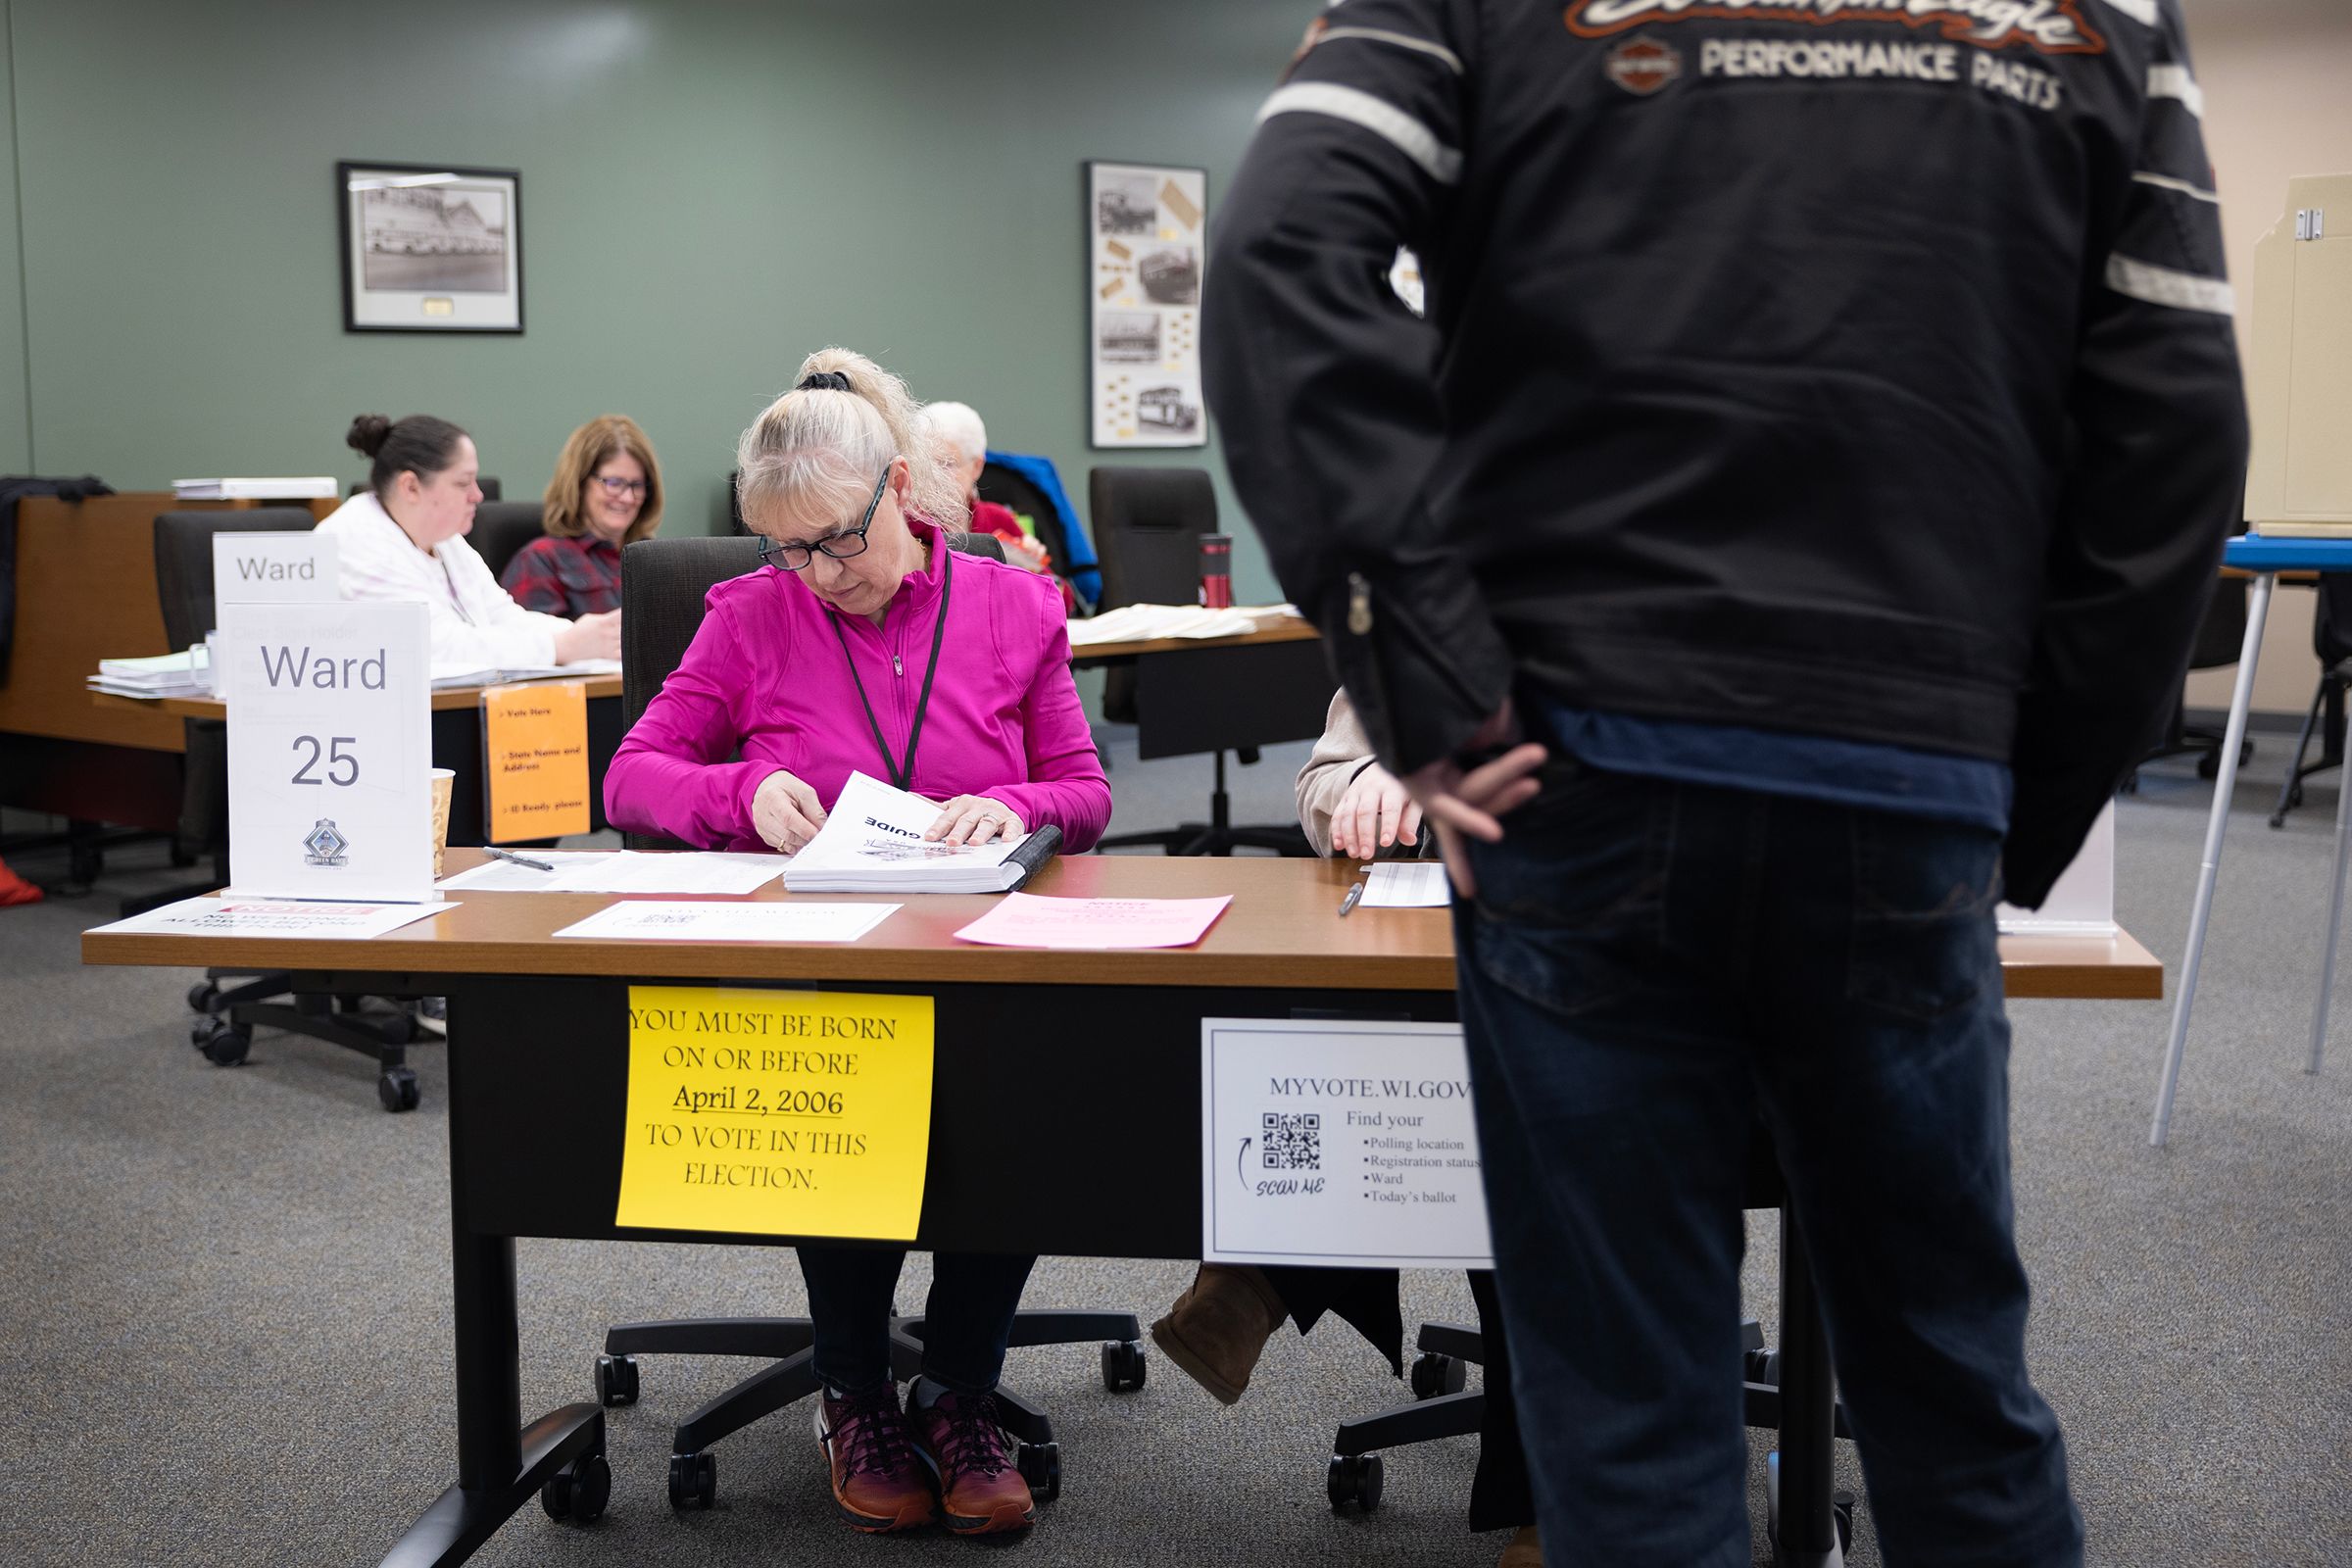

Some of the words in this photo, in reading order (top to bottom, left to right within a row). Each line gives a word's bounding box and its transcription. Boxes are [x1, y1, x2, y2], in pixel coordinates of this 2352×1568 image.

[1700, 37, 1958, 81] PERFORMANCE
[1971, 52, 2062, 111] PARTS
[238, 557, 315, 580] Ward
[261, 645, 386, 690] Ward
[291, 736, 359, 786] 25
[534, 750, 561, 759] Name
[564, 746, 581, 755] and
[504, 764, 540, 773] Address
[522, 803, 550, 812] Ready
[864, 816, 921, 840] GUIDE
[630, 1009, 687, 1030] YOU
[696, 1012, 773, 1035] MUST
[782, 1015, 811, 1037] BE
[821, 1017, 897, 1041] BORN
[663, 1046, 706, 1068] ON
[714, 1048, 752, 1070] OR
[761, 1052, 858, 1075] BEFORE
[672, 1084, 736, 1113] April
[746, 1090, 768, 1116] 2,
[777, 1092, 844, 1114] 2006
[1270, 1078, 1473, 1100] MYVOTE.WI.GOV
[1347, 1111, 1382, 1127] Find
[1388, 1115, 1424, 1130] your
[646, 1123, 682, 1147] TO
[692, 1126, 761, 1151] VOTE
[771, 1131, 800, 1152] IN
[808, 1133, 867, 1156] THIS
[1371, 1137, 1413, 1152] Polling
[1417, 1139, 1464, 1151] location
[1371, 1155, 1443, 1170] Registration
[1446, 1157, 1481, 1169] status
[684, 1162, 818, 1190] ELECTION.
[1371, 1173, 1402, 1185] Ward
[1256, 1180, 1298, 1197] SCAN
[1301, 1178, 1325, 1195] ME
[1371, 1192, 1419, 1205] Today’s
[1422, 1192, 1456, 1203] ballot
